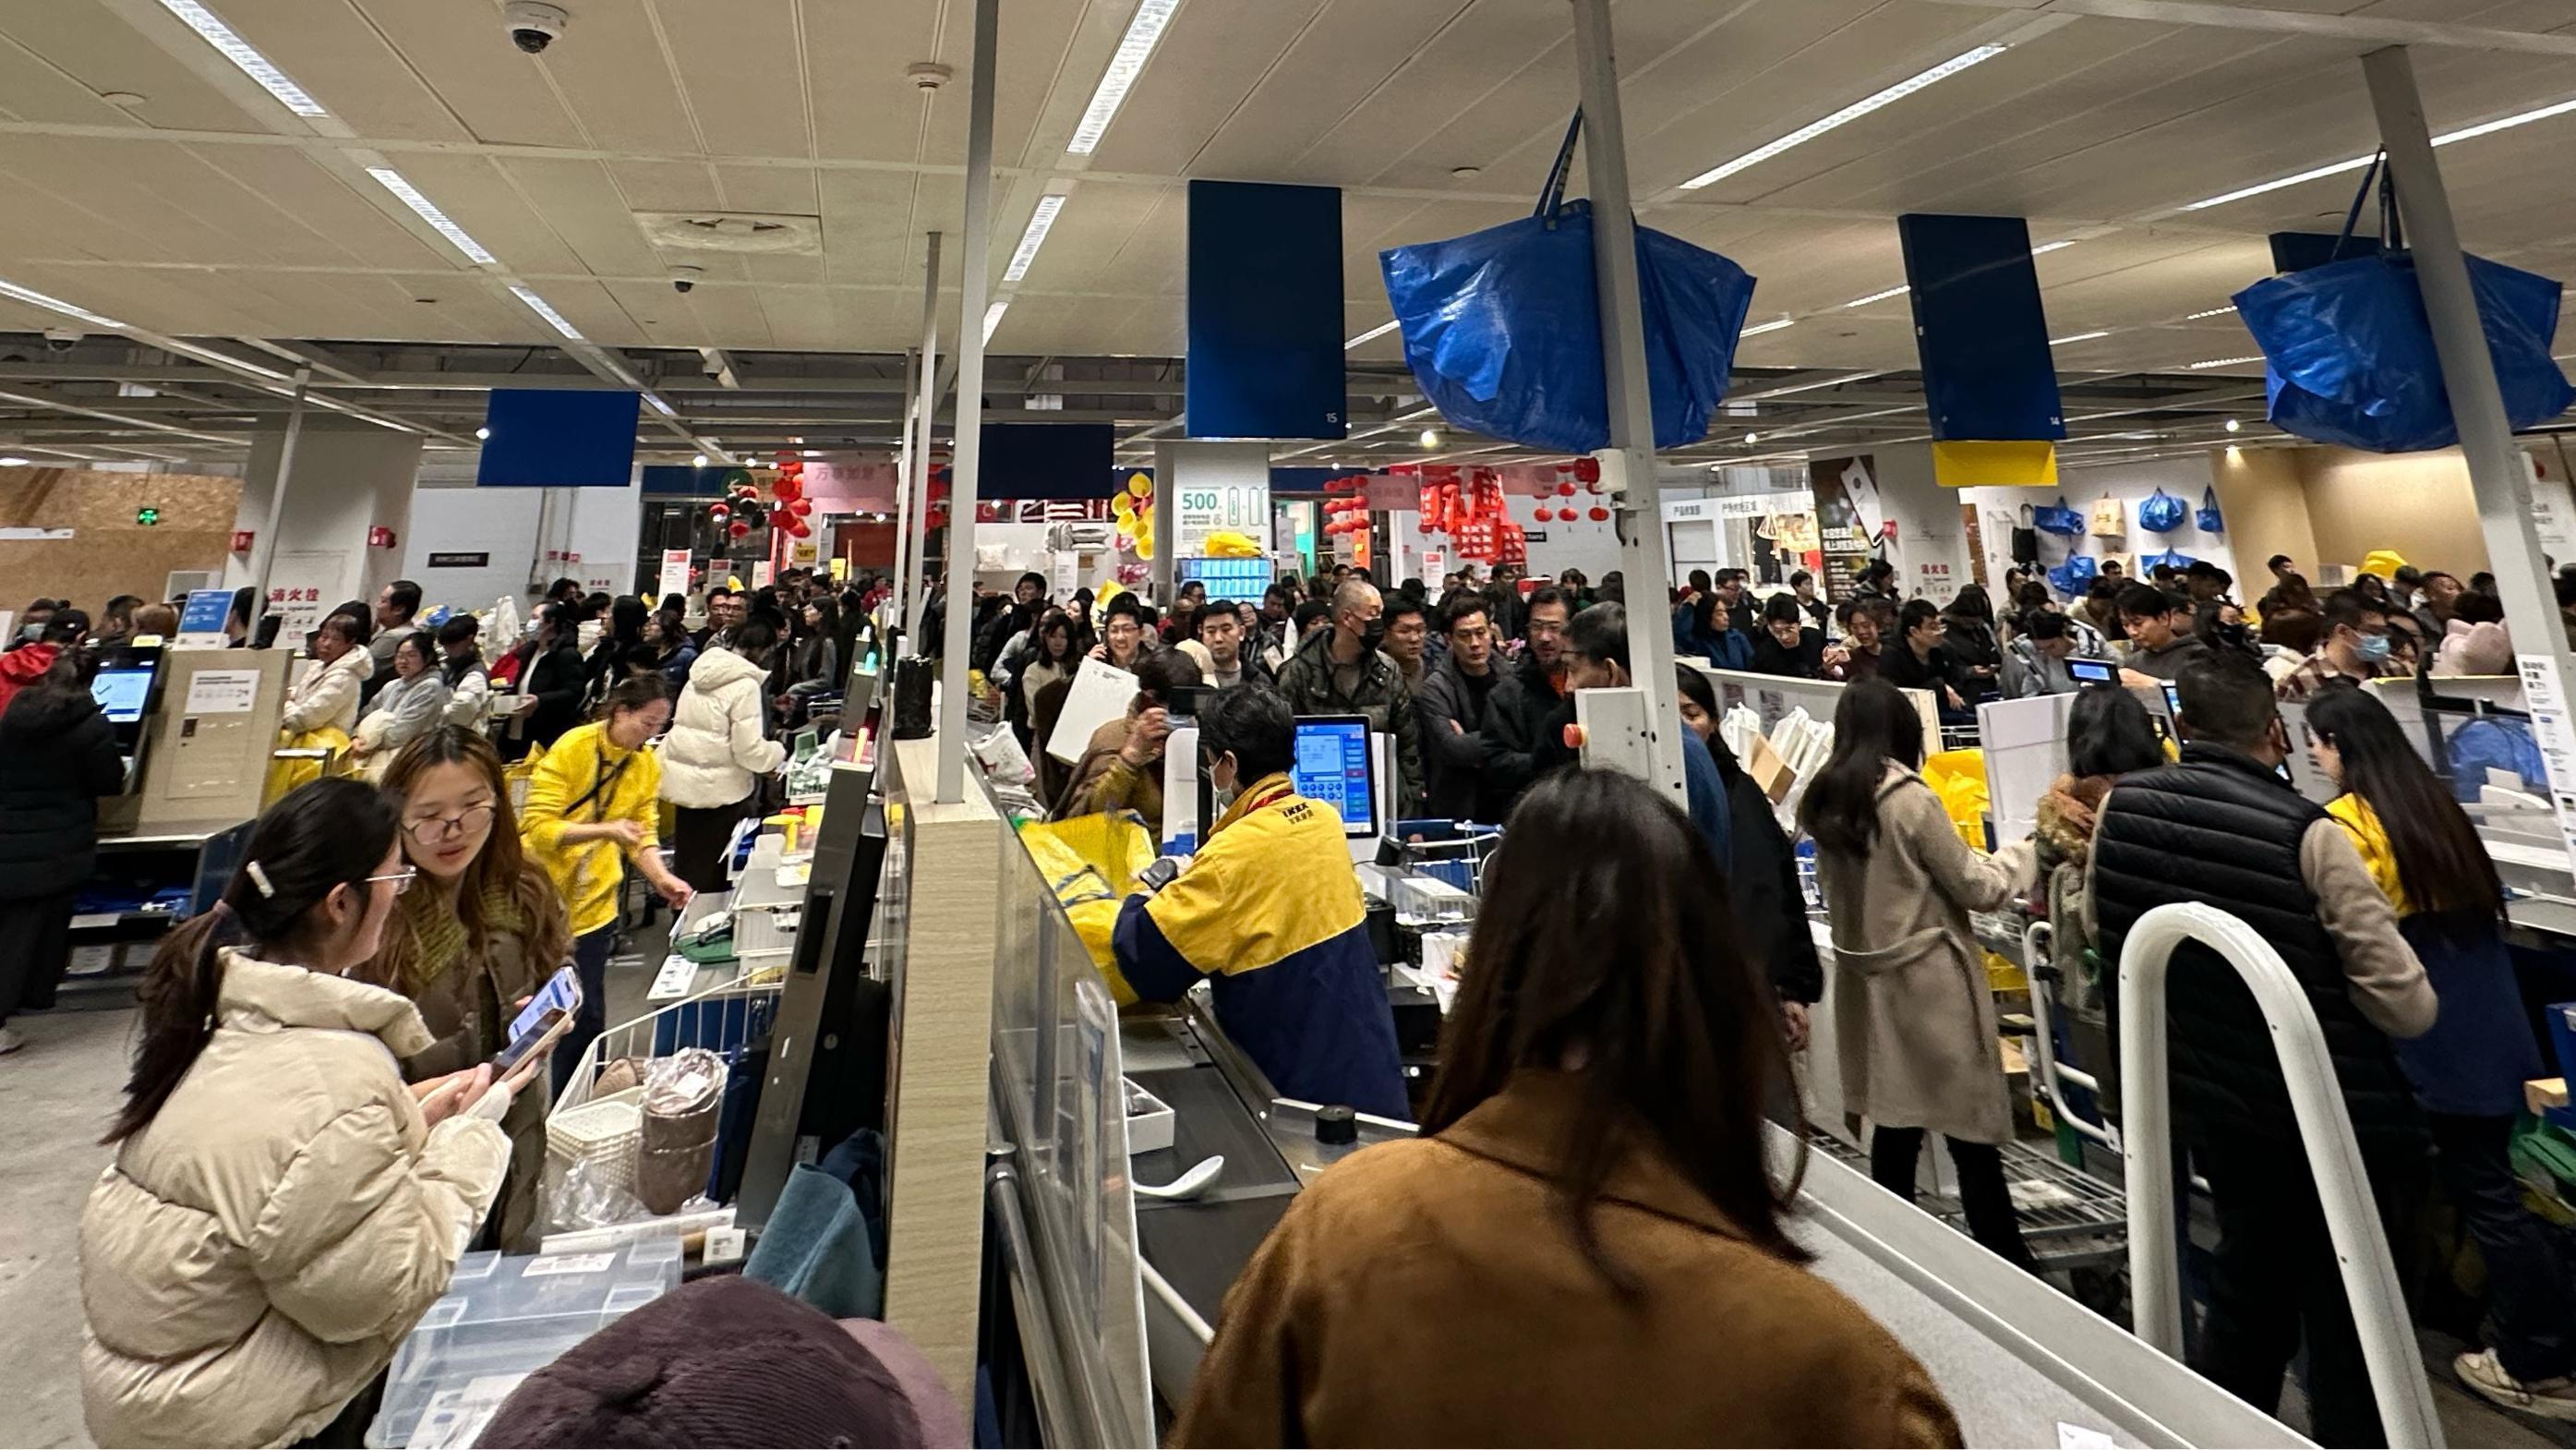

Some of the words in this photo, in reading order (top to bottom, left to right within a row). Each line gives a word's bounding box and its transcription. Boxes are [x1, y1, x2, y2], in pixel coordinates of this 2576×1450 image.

[1326, 412, 1338, 423] 15
[2049, 417, 2060, 426] 14
[1182, 492, 1217, 510] 500
[269, 586, 319, 603] 消火栓
[1282, 802, 1308, 818] IKEA
